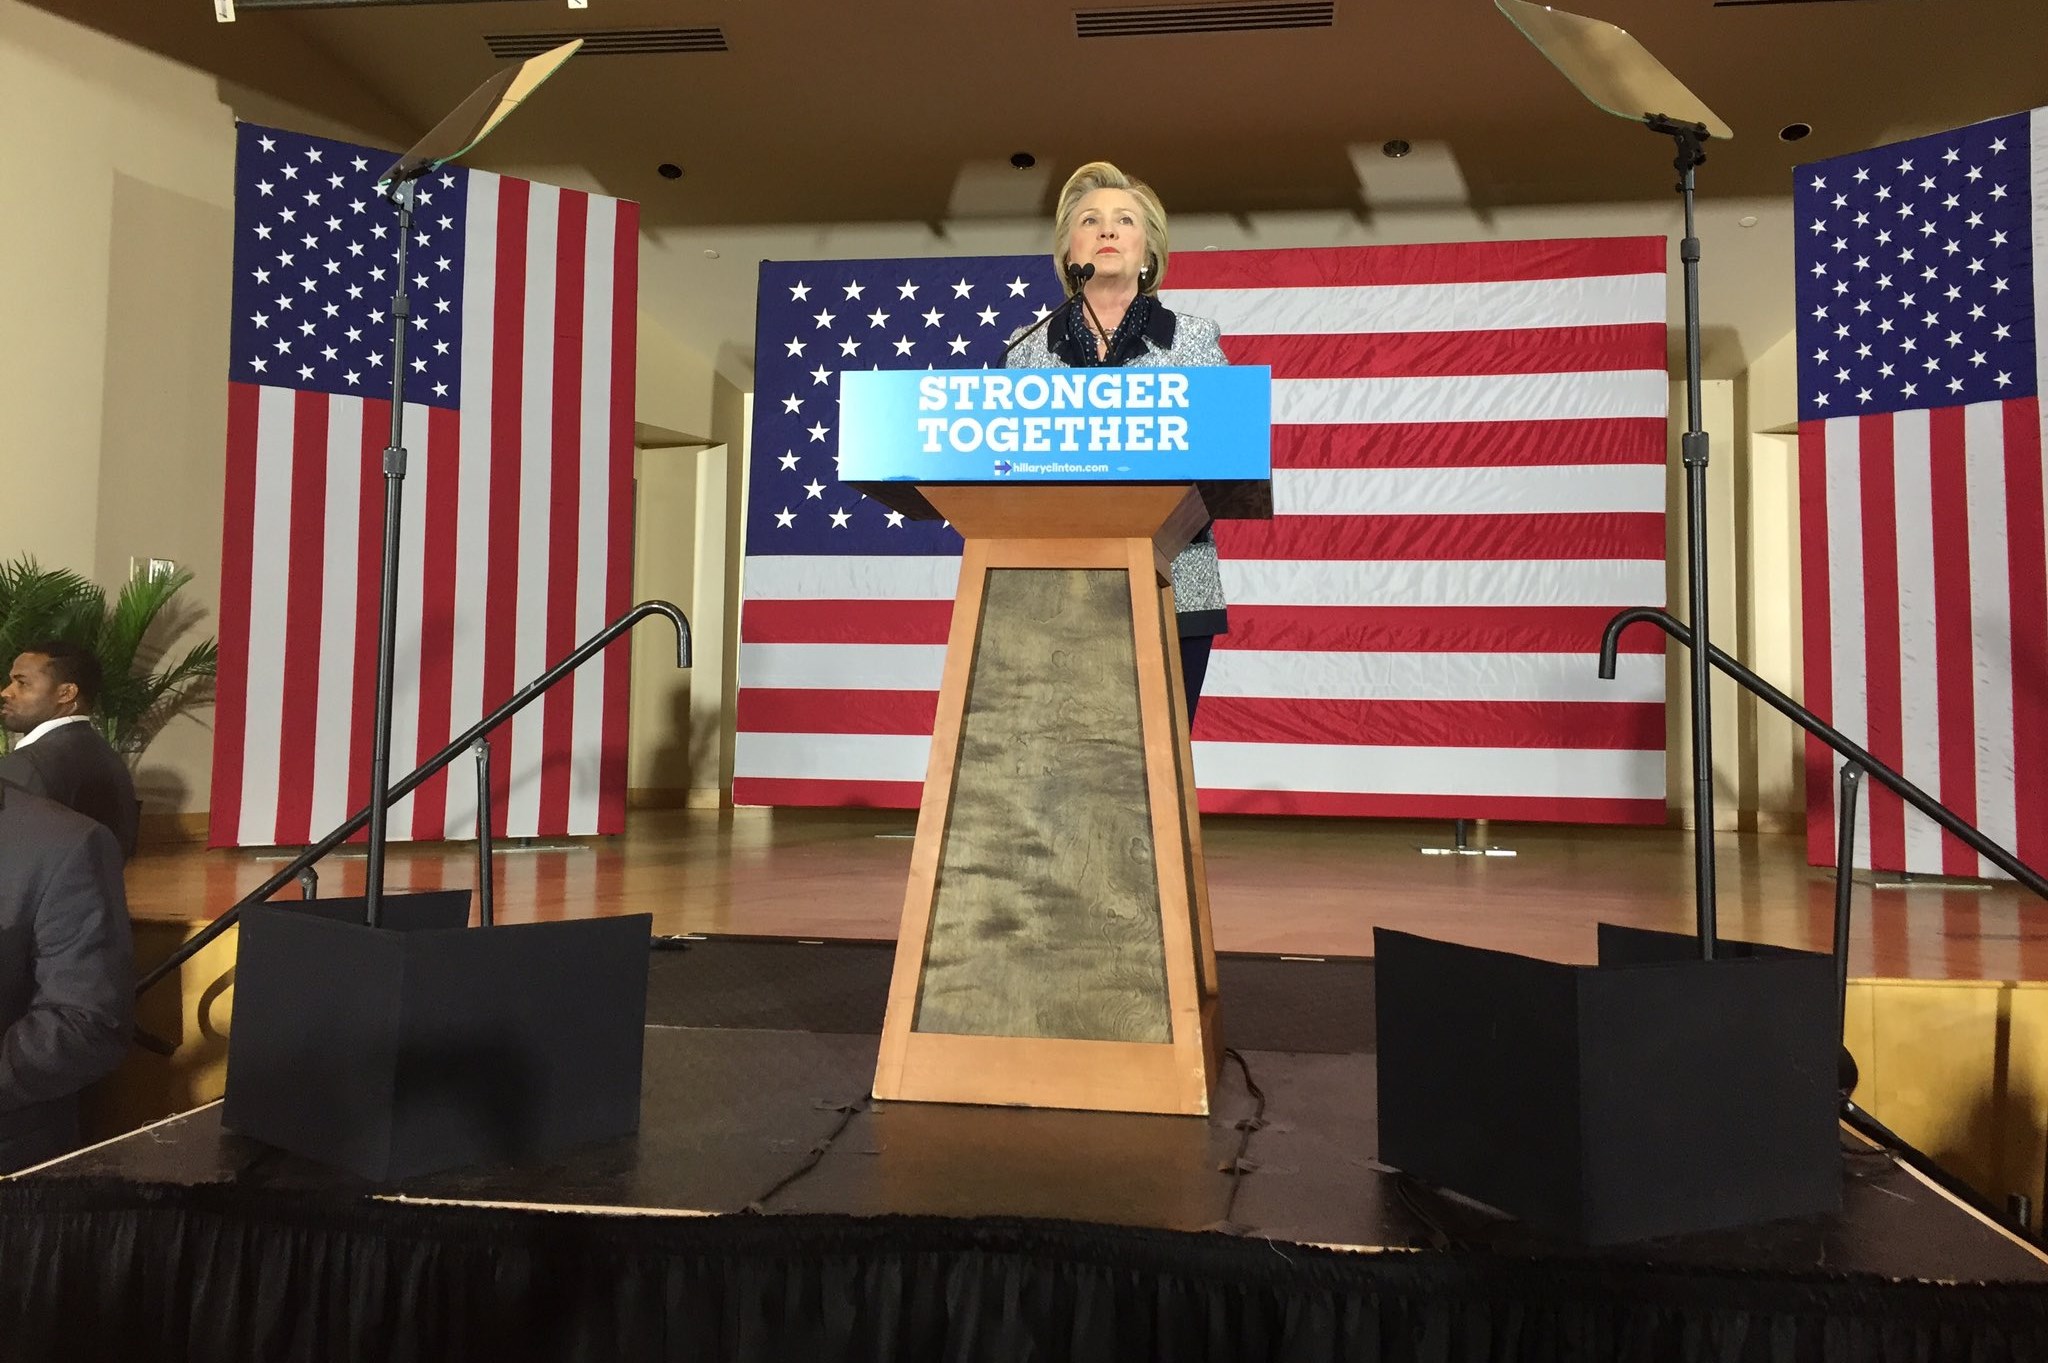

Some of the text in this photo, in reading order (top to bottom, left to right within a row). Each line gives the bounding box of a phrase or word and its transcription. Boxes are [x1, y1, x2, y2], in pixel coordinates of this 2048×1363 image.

[918, 373, 1189, 410] STRONGER
[917, 416, 1189, 453] TOGETHER
[1012, 462, 1109, 475] hillaryclinton.com
